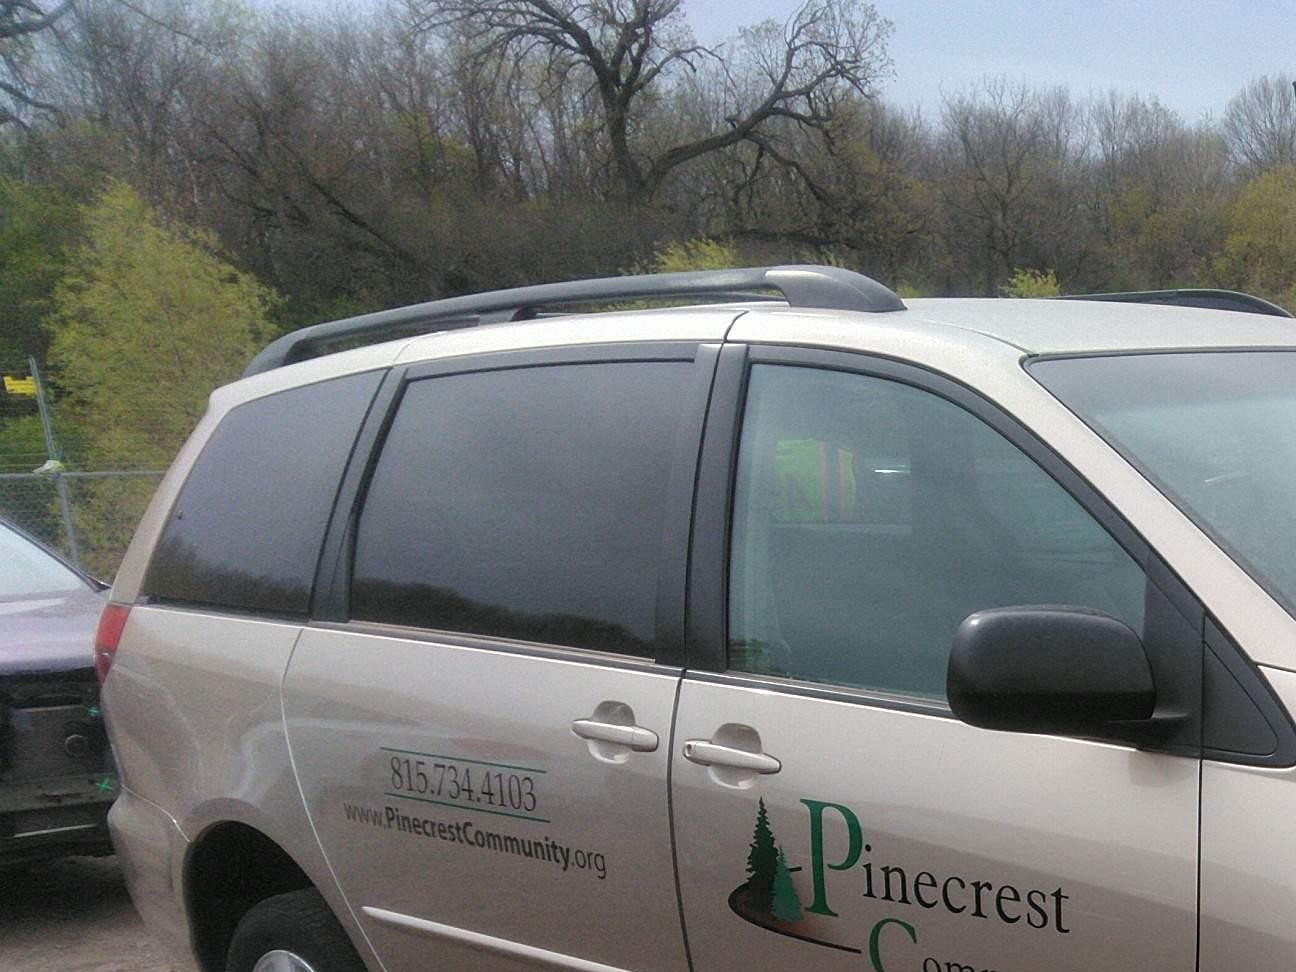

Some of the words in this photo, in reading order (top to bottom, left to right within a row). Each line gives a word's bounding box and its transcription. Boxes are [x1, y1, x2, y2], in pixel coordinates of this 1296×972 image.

[390, 756, 538, 812] 815.734.4103
[343, 801, 608, 880] www.PinecrestCommunity.org
[800, 798, 1071, 934] Pinecrest
